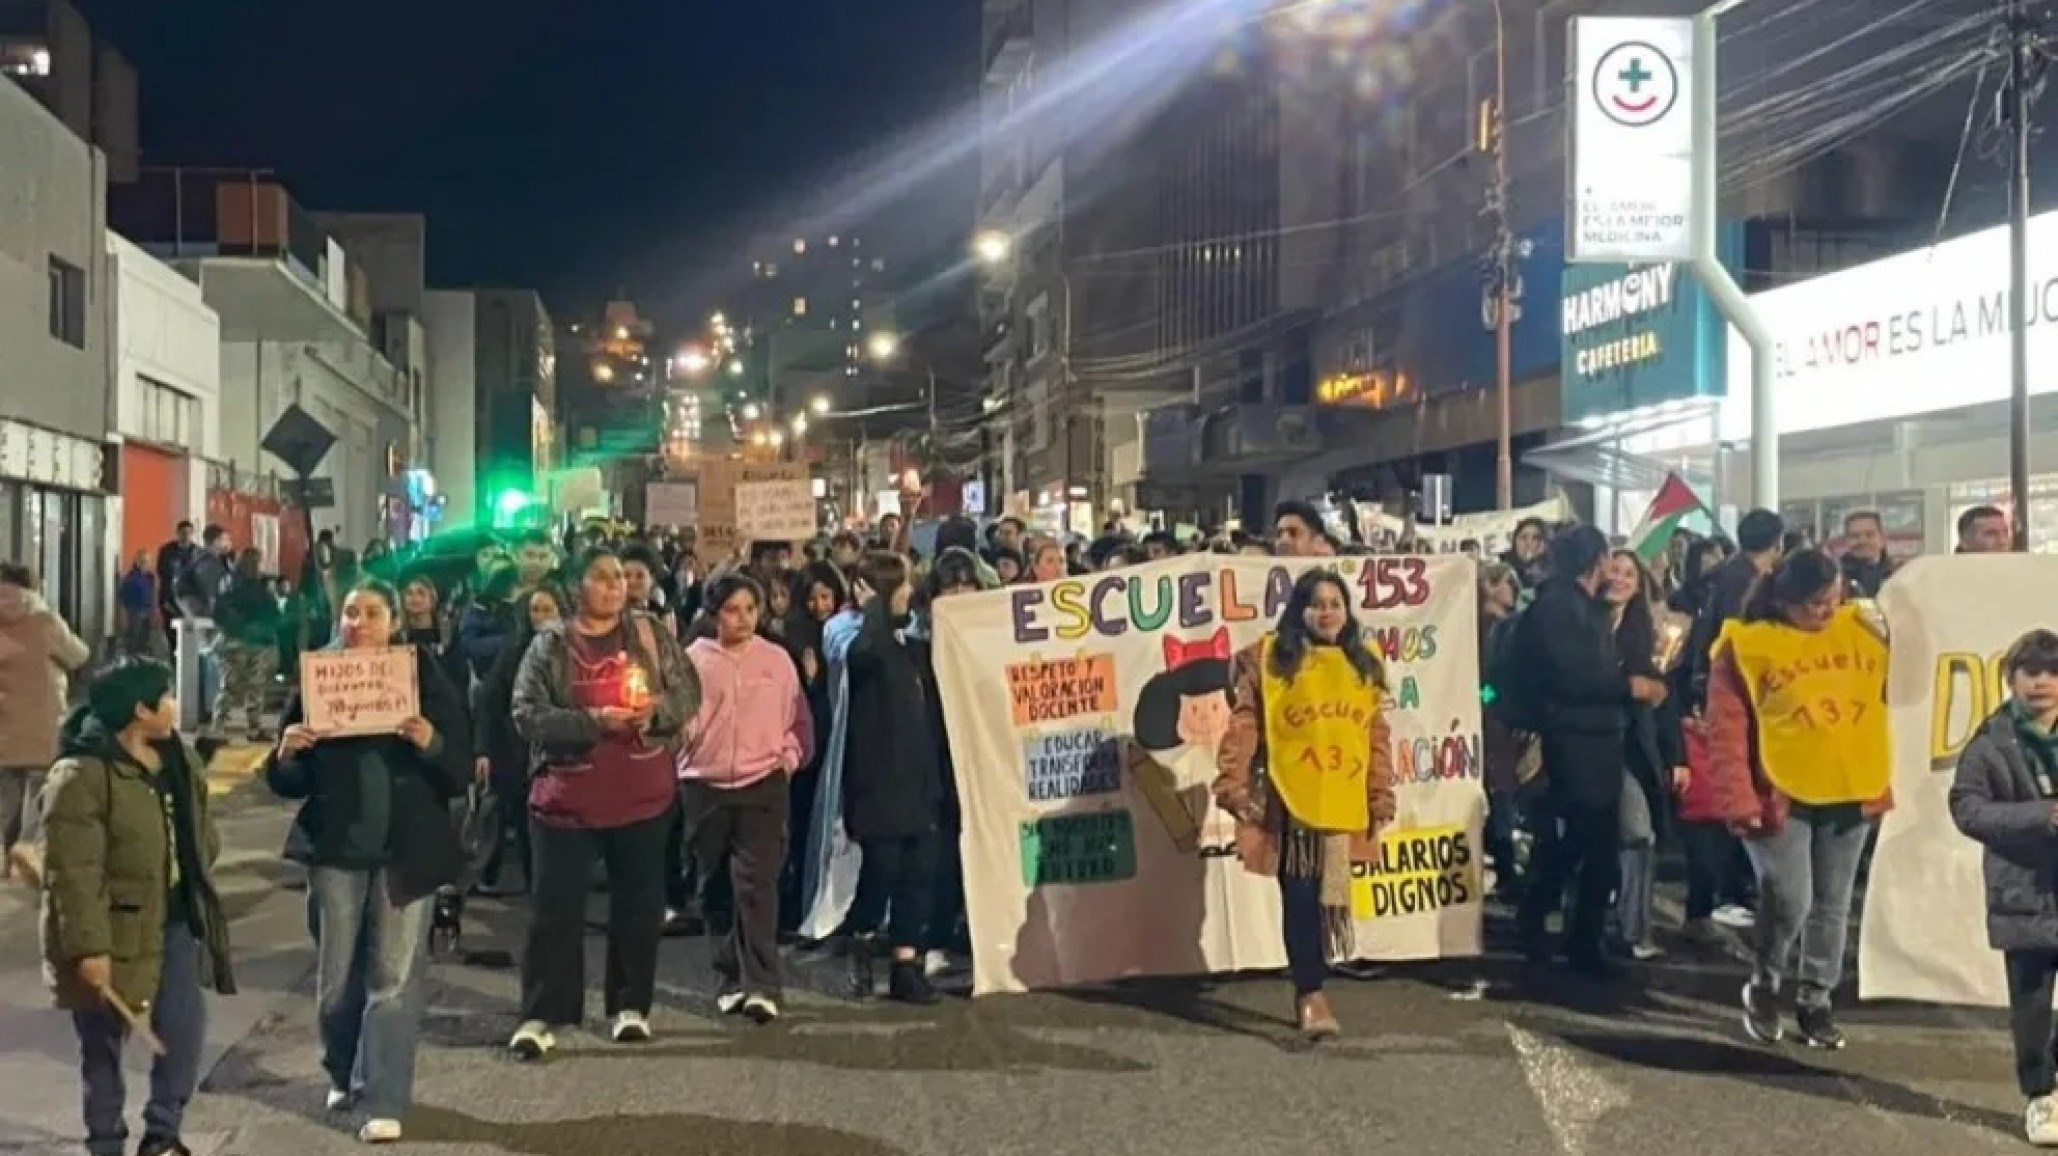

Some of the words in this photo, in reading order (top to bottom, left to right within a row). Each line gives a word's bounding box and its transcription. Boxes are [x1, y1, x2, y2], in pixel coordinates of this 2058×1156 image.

[1562, 261, 1673, 335] HARMONY
[1805, 320, 1880, 368] AMOR
[1889, 310, 1922, 355] ES
[1933, 299, 1967, 346] LA
[1978, 277, 2058, 337] MJO
[1356, 557, 1431, 610] 153
[1006, 660, 1077, 683] RESPETO
[1028, 697, 1101, 721] DOCENTE
[1372, 871, 1468, 917] DIGNOS
